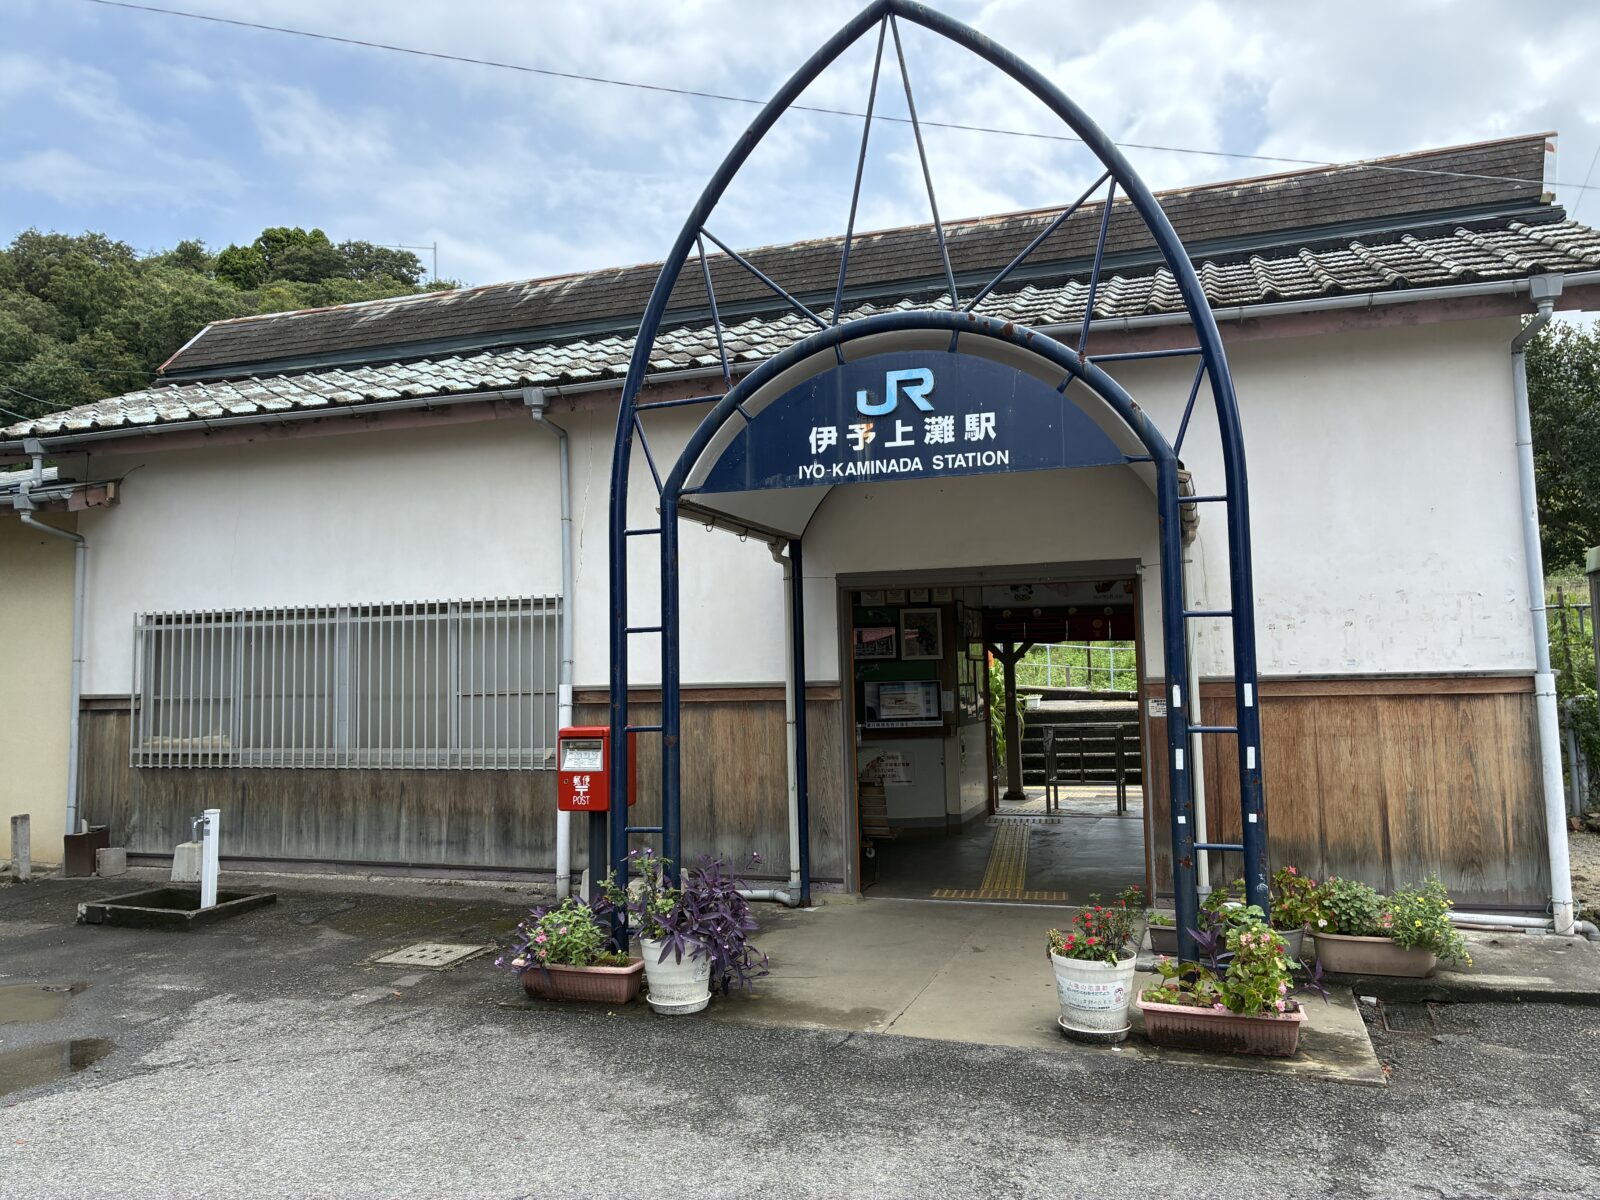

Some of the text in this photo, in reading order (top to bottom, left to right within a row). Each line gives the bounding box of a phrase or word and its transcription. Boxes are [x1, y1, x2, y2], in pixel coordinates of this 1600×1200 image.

[856, 367, 935, 416] JR
[809, 412, 996, 454] 伊予上灘駅
[799, 450, 1010, 480] IYO-KAMINADA STATION
[573, 795, 590, 805] POST
